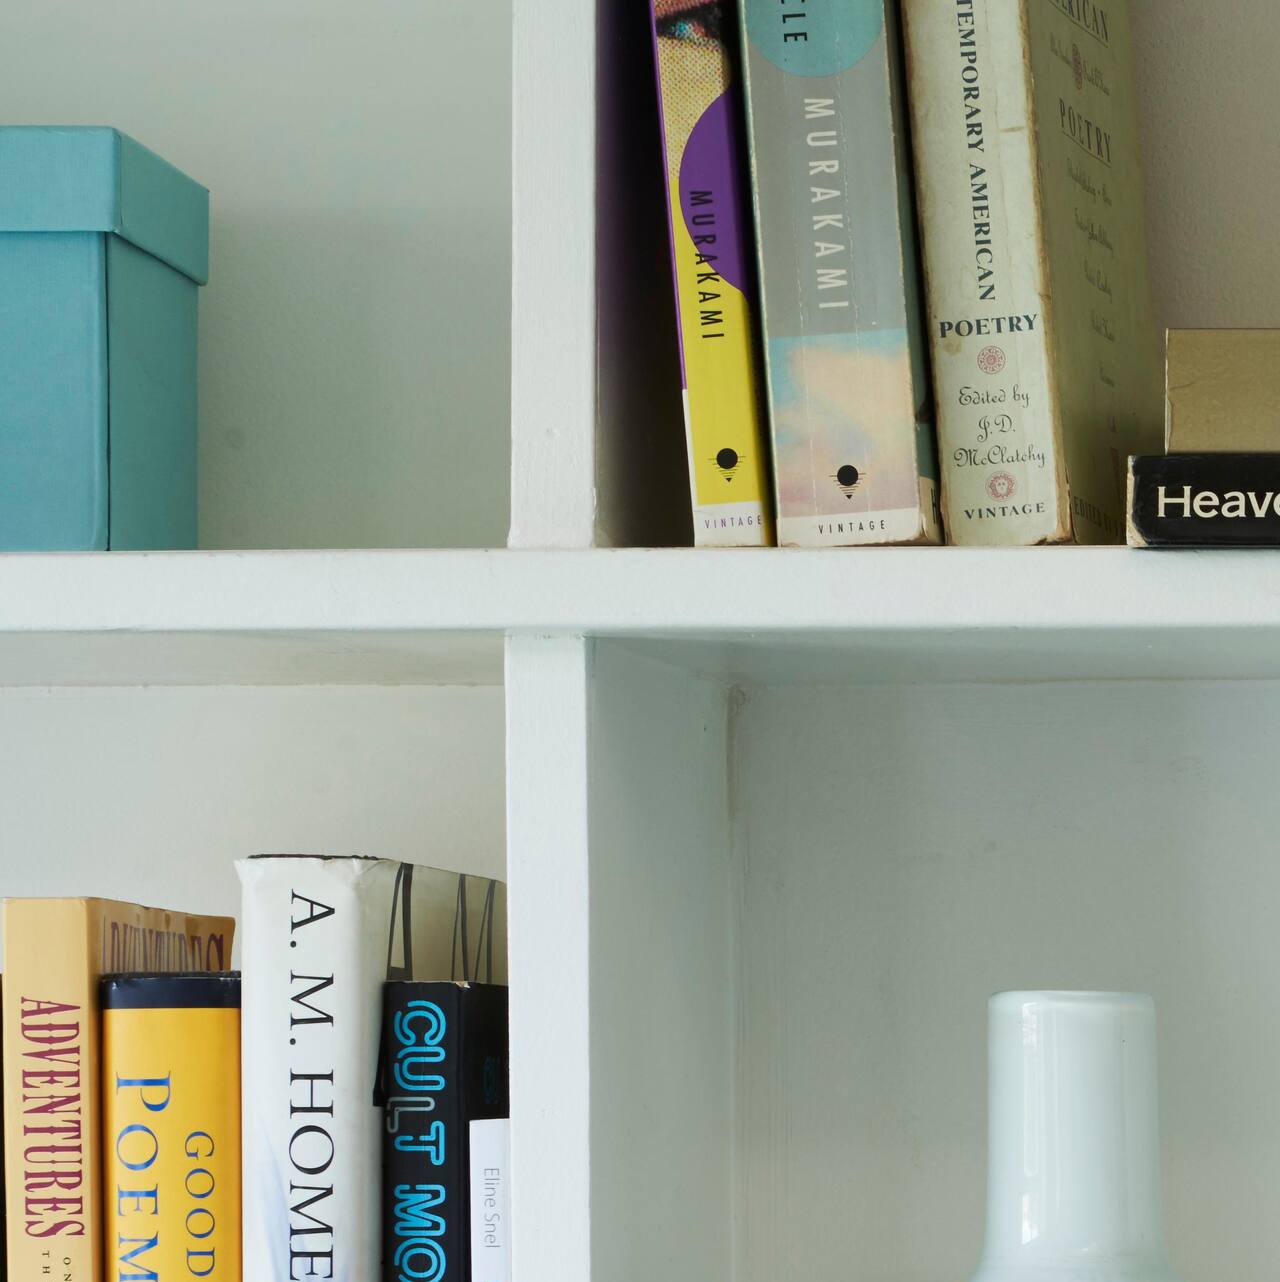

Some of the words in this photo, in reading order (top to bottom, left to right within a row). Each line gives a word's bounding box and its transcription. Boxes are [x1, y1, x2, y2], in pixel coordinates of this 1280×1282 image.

[781, 0, 808, 44] LE
[804, 97, 849, 310] MURAKAMI
[969, 163, 997, 300] AMERICAN
[689, 189, 725, 339] MURAKAMI
[938, 313, 1038, 339] POETRY
[958, 386, 1006, 406] Edited
[1013, 384, 1030, 408] by
[953, 444, 1046, 469] McClatchy
[704, 514, 763, 530] VINTAGE
[818, 518, 886, 535] VINTAGE
[963, 502, 1045, 520] VINTAGE
[289, 889, 336, 948] A.
[289, 973, 335, 1046] M.
[388, 1000, 446, 1166] CULT
[20, 996, 85, 1239] ADVENTURES
[184, 1130, 215, 1277] GOOD
[484, 1167, 500, 1207] Eline
[484, 1213, 499, 1248] Snel
[63, 1257, 72, 1282] ON
